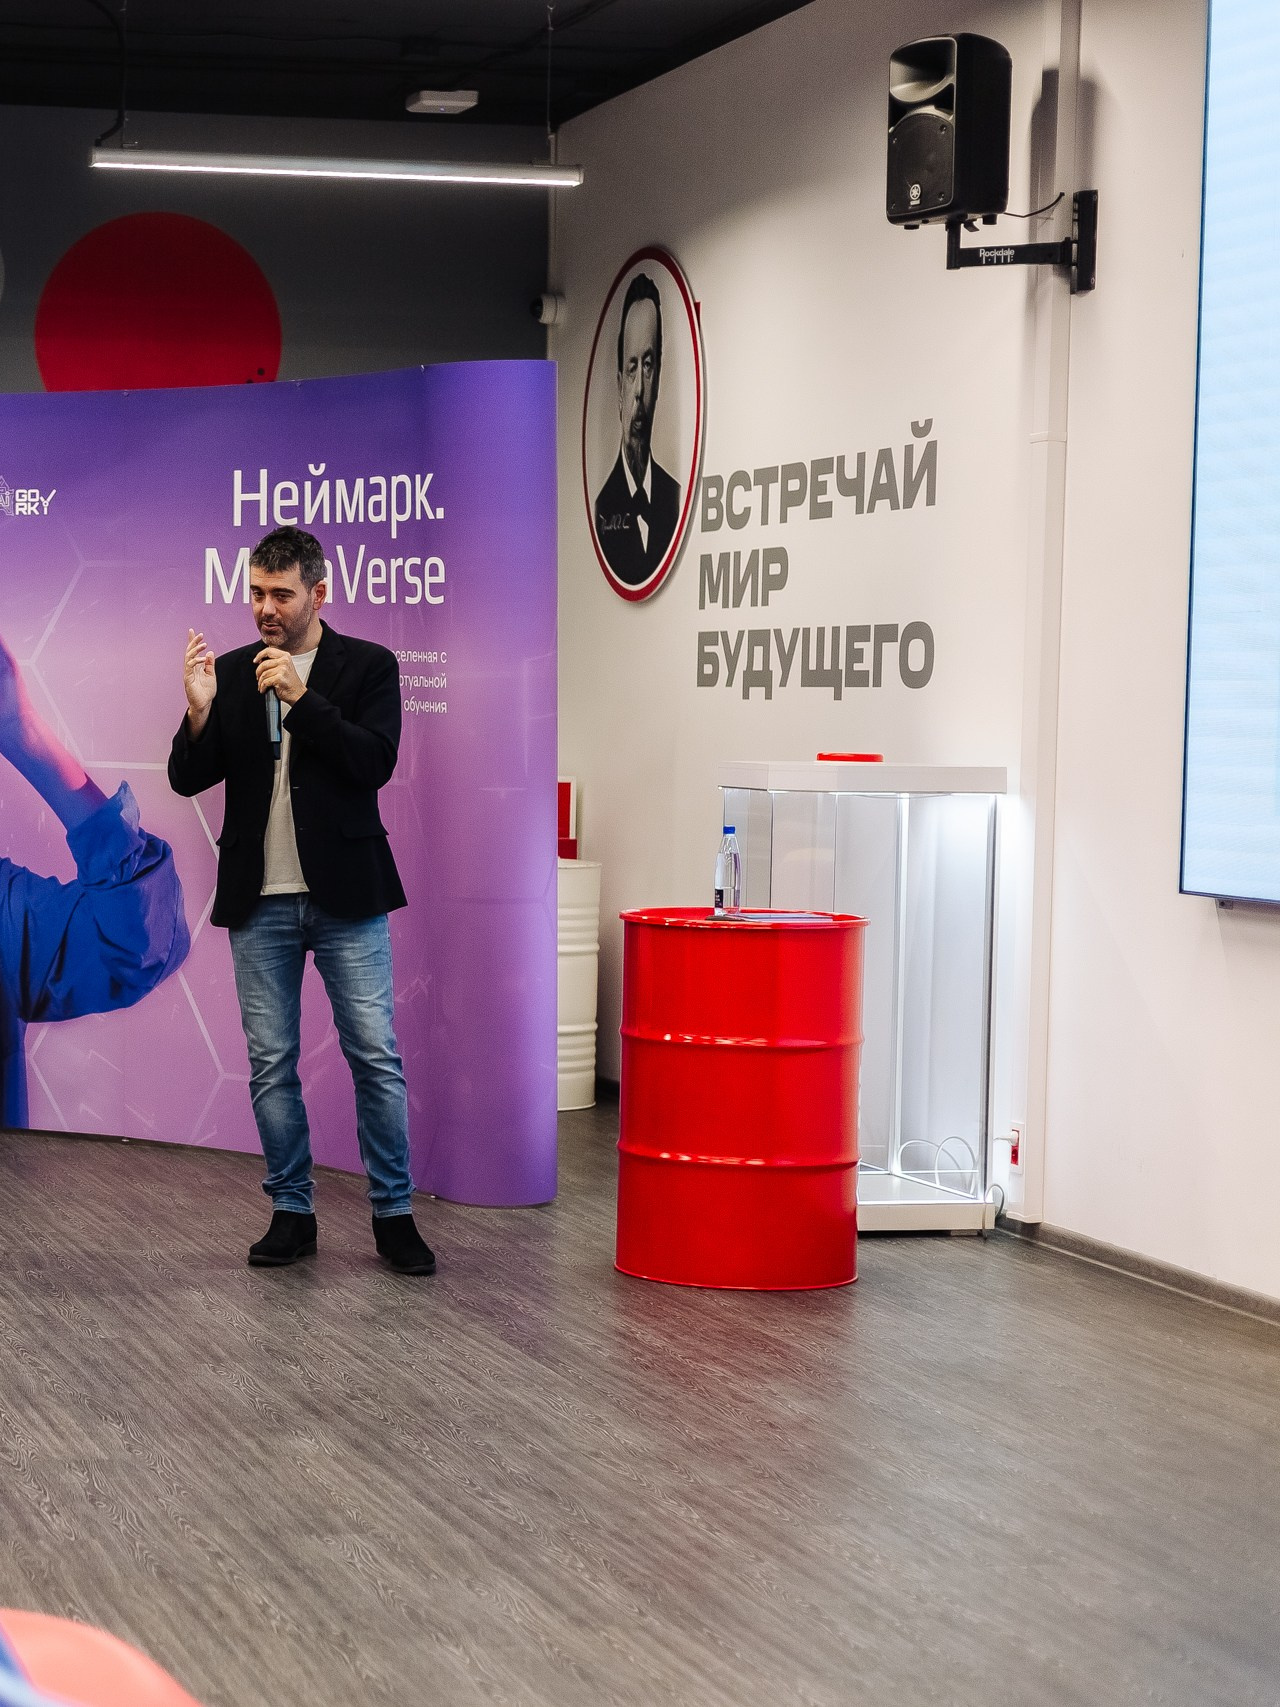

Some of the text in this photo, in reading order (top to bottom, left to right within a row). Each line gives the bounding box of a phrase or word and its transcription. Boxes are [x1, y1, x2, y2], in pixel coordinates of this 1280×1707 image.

[979, 248, 1015, 263] Rockdale
[232, 462, 445, 539] Неймарк.
[700, 418, 938, 533] ВСТРЕЧАЙ
[204, 544, 446, 605] MVerse
[698, 546, 789, 610] МИР
[392, 650, 438, 663] селенная
[696, 620, 935, 701] БУДУЩЕГО
[403, 695, 448, 715] обучения
